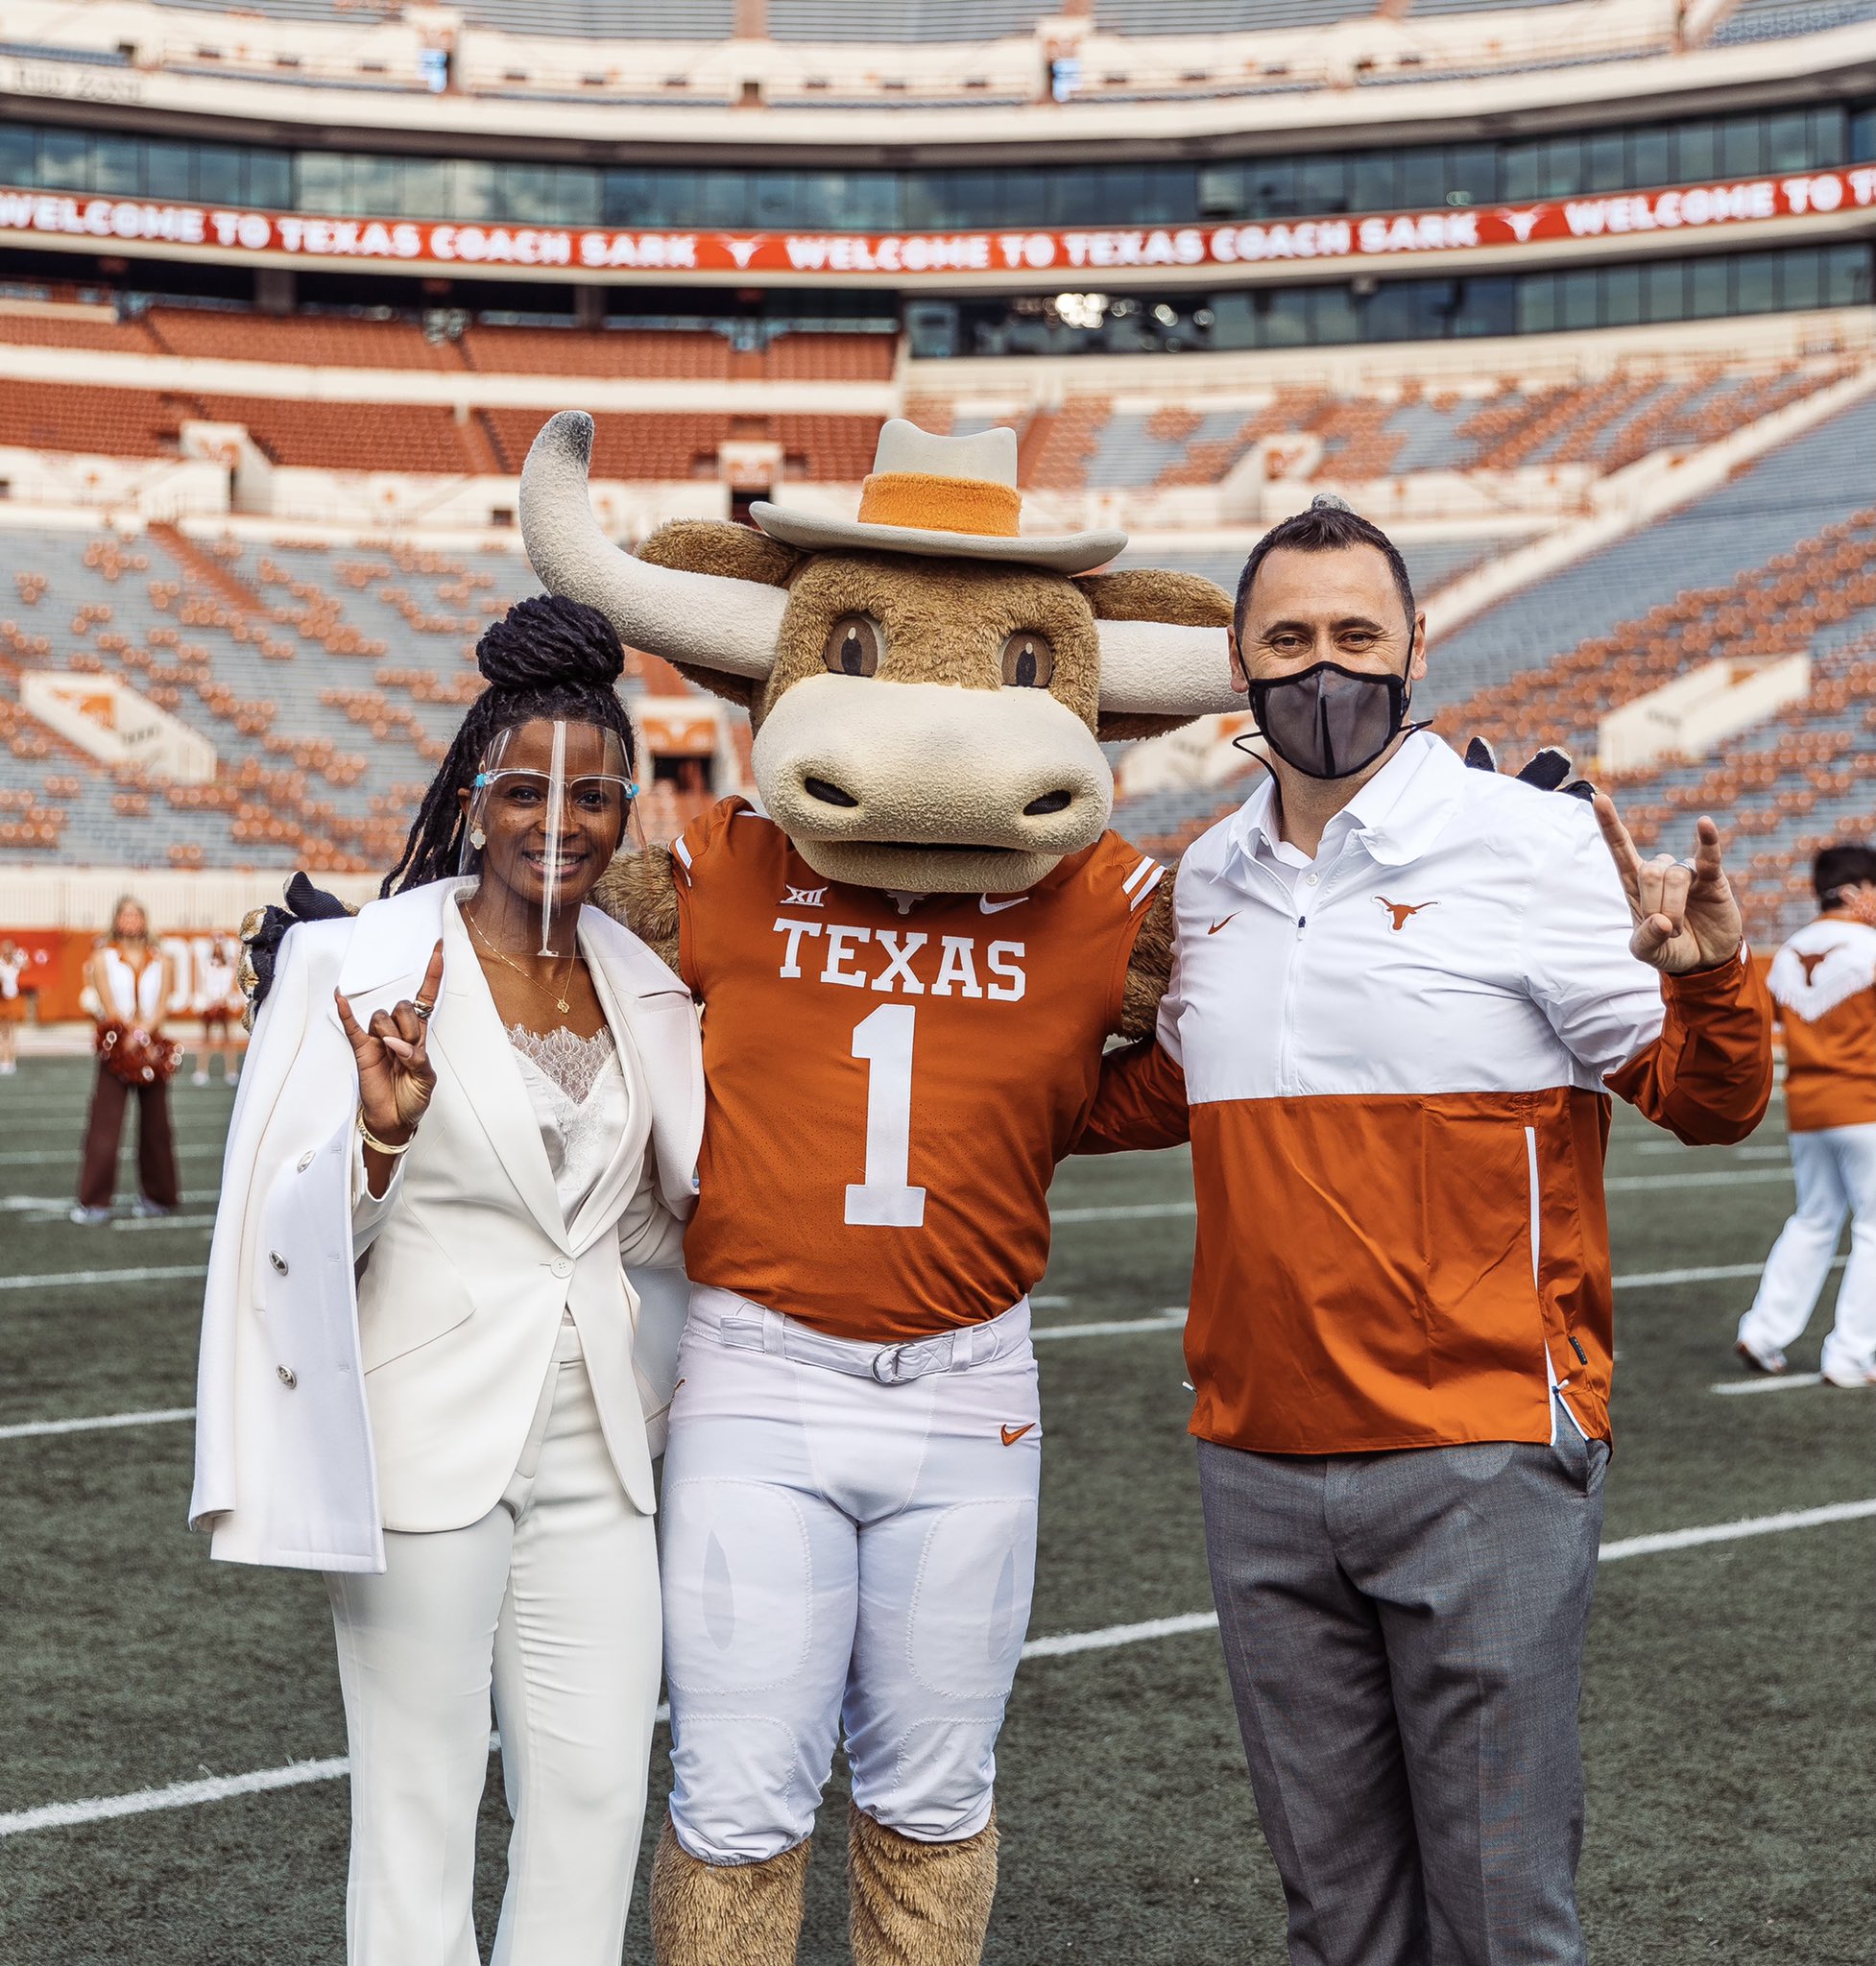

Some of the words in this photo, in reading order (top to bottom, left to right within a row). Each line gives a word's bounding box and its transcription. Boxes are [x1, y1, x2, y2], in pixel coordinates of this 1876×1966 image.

[0, 193, 204, 244] WELCOME
[211, 210, 271, 249] TO
[276, 216, 421, 258] TEXAS
[430, 226, 571, 264] COACH
[580, 231, 697, 268] SARK
[1564, 180, 1775, 236] WELCOME
[1782, 174, 1842, 214] TO
[1848, 168, 1876, 205] T
[784, 235, 989, 271] WELCOME
[998, 233, 1055, 269] TO
[1062, 228, 1205, 267] TEXAS
[1212, 220, 1351, 263] COACH
[1359, 212, 1478, 253] SARK
[773, 917, 1027, 1002] TEXAS
[844, 1003, 926, 1228] 1
